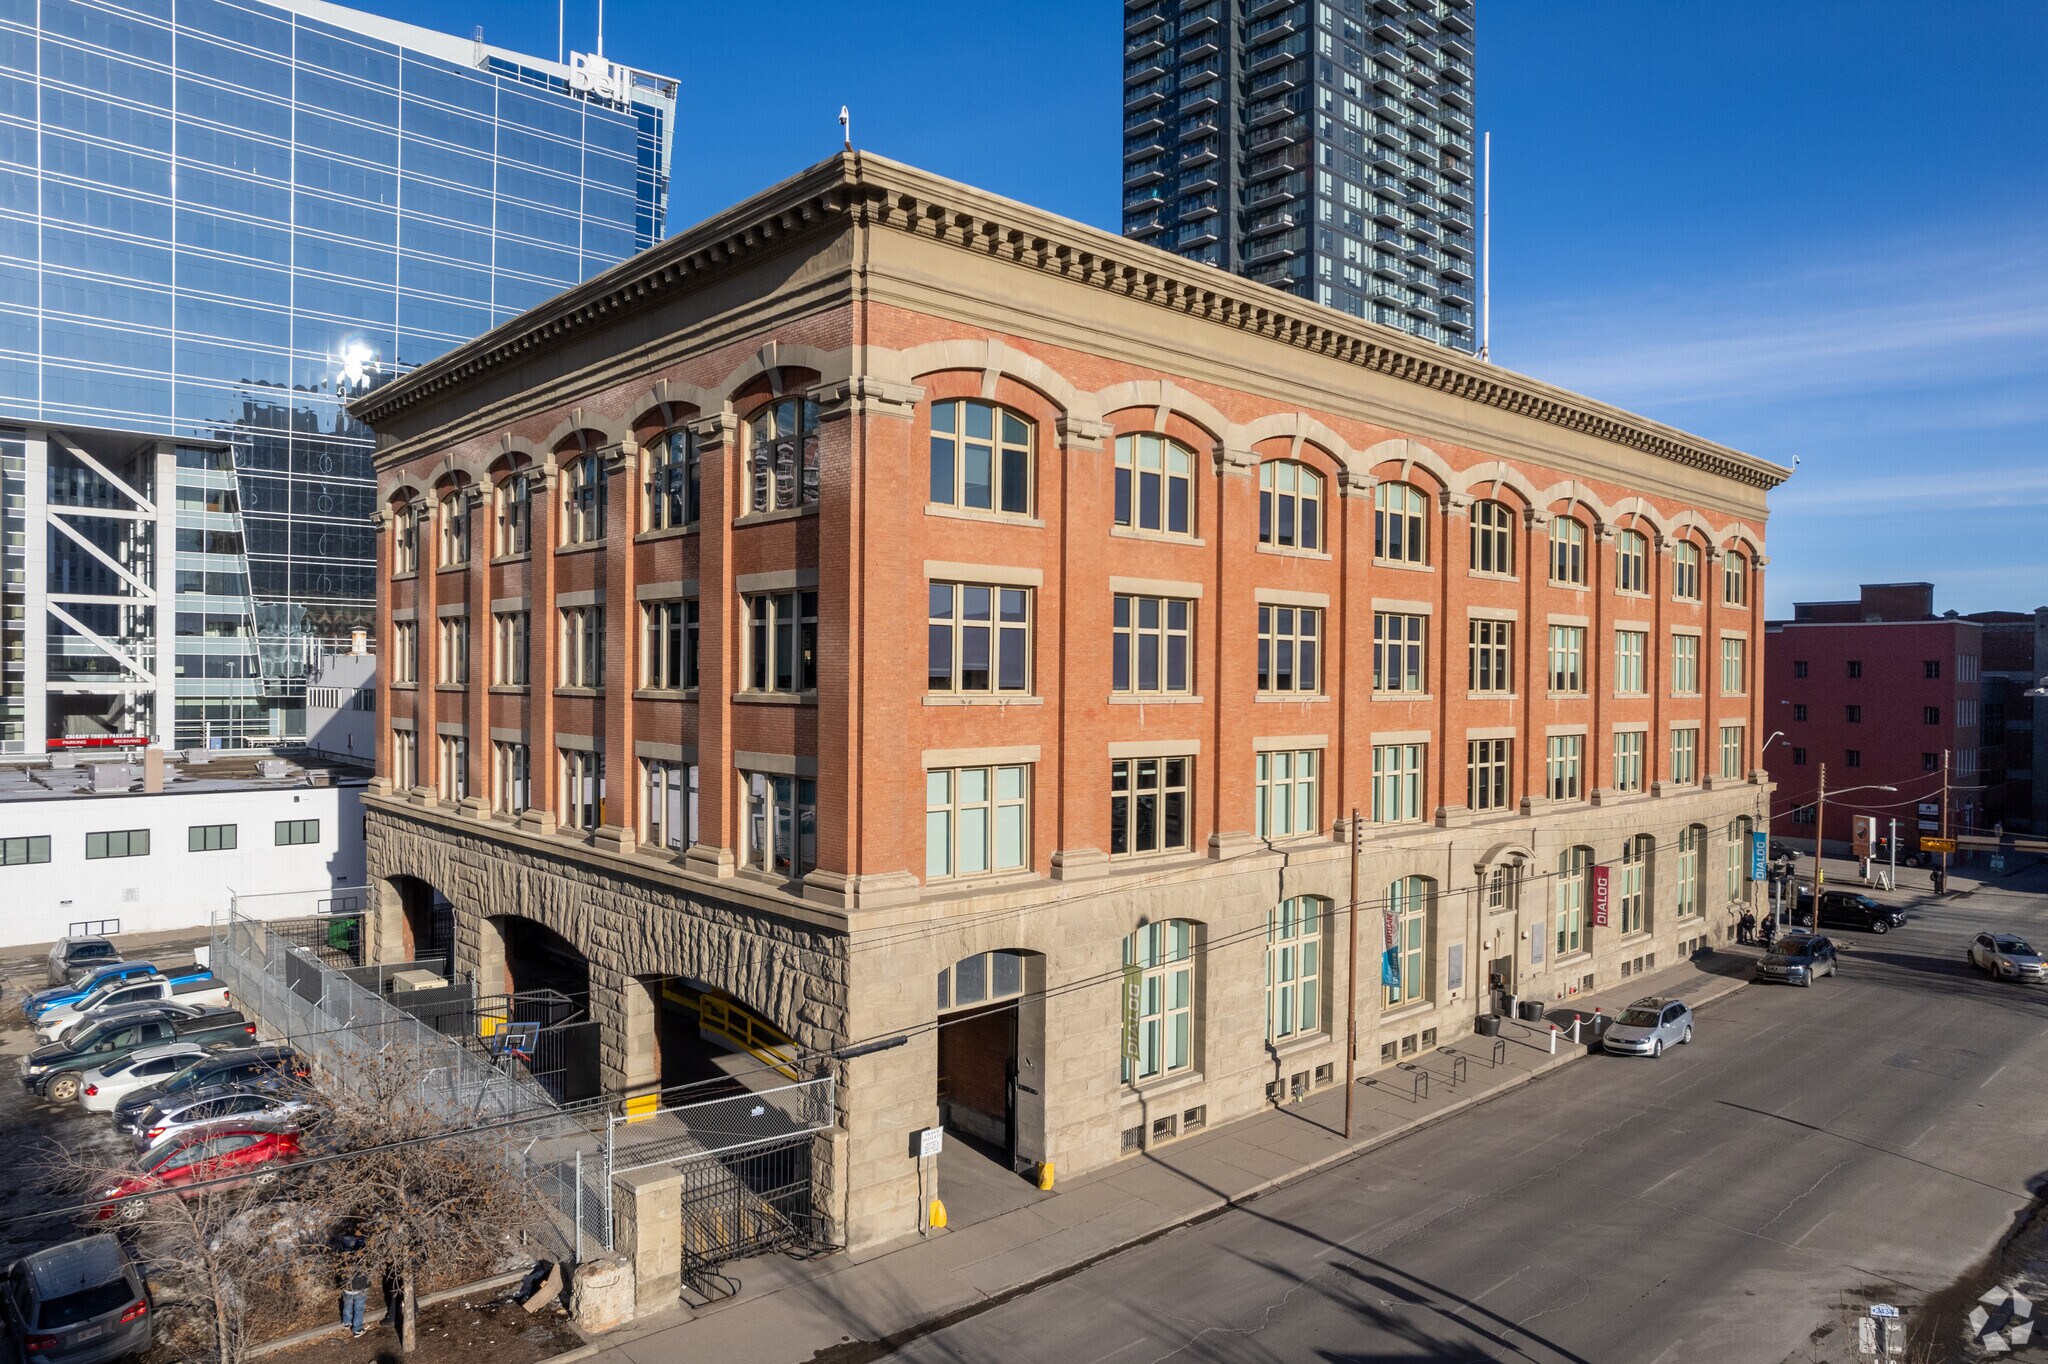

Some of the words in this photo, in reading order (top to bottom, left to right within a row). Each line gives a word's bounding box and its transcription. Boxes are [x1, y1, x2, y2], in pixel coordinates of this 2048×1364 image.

[569, 50, 630, 104] Bell
[1755, 841, 1766, 879] DIALOG
[1597, 877, 1608, 924] DIALOG
[1128, 984, 1140, 1056] DIALOG
